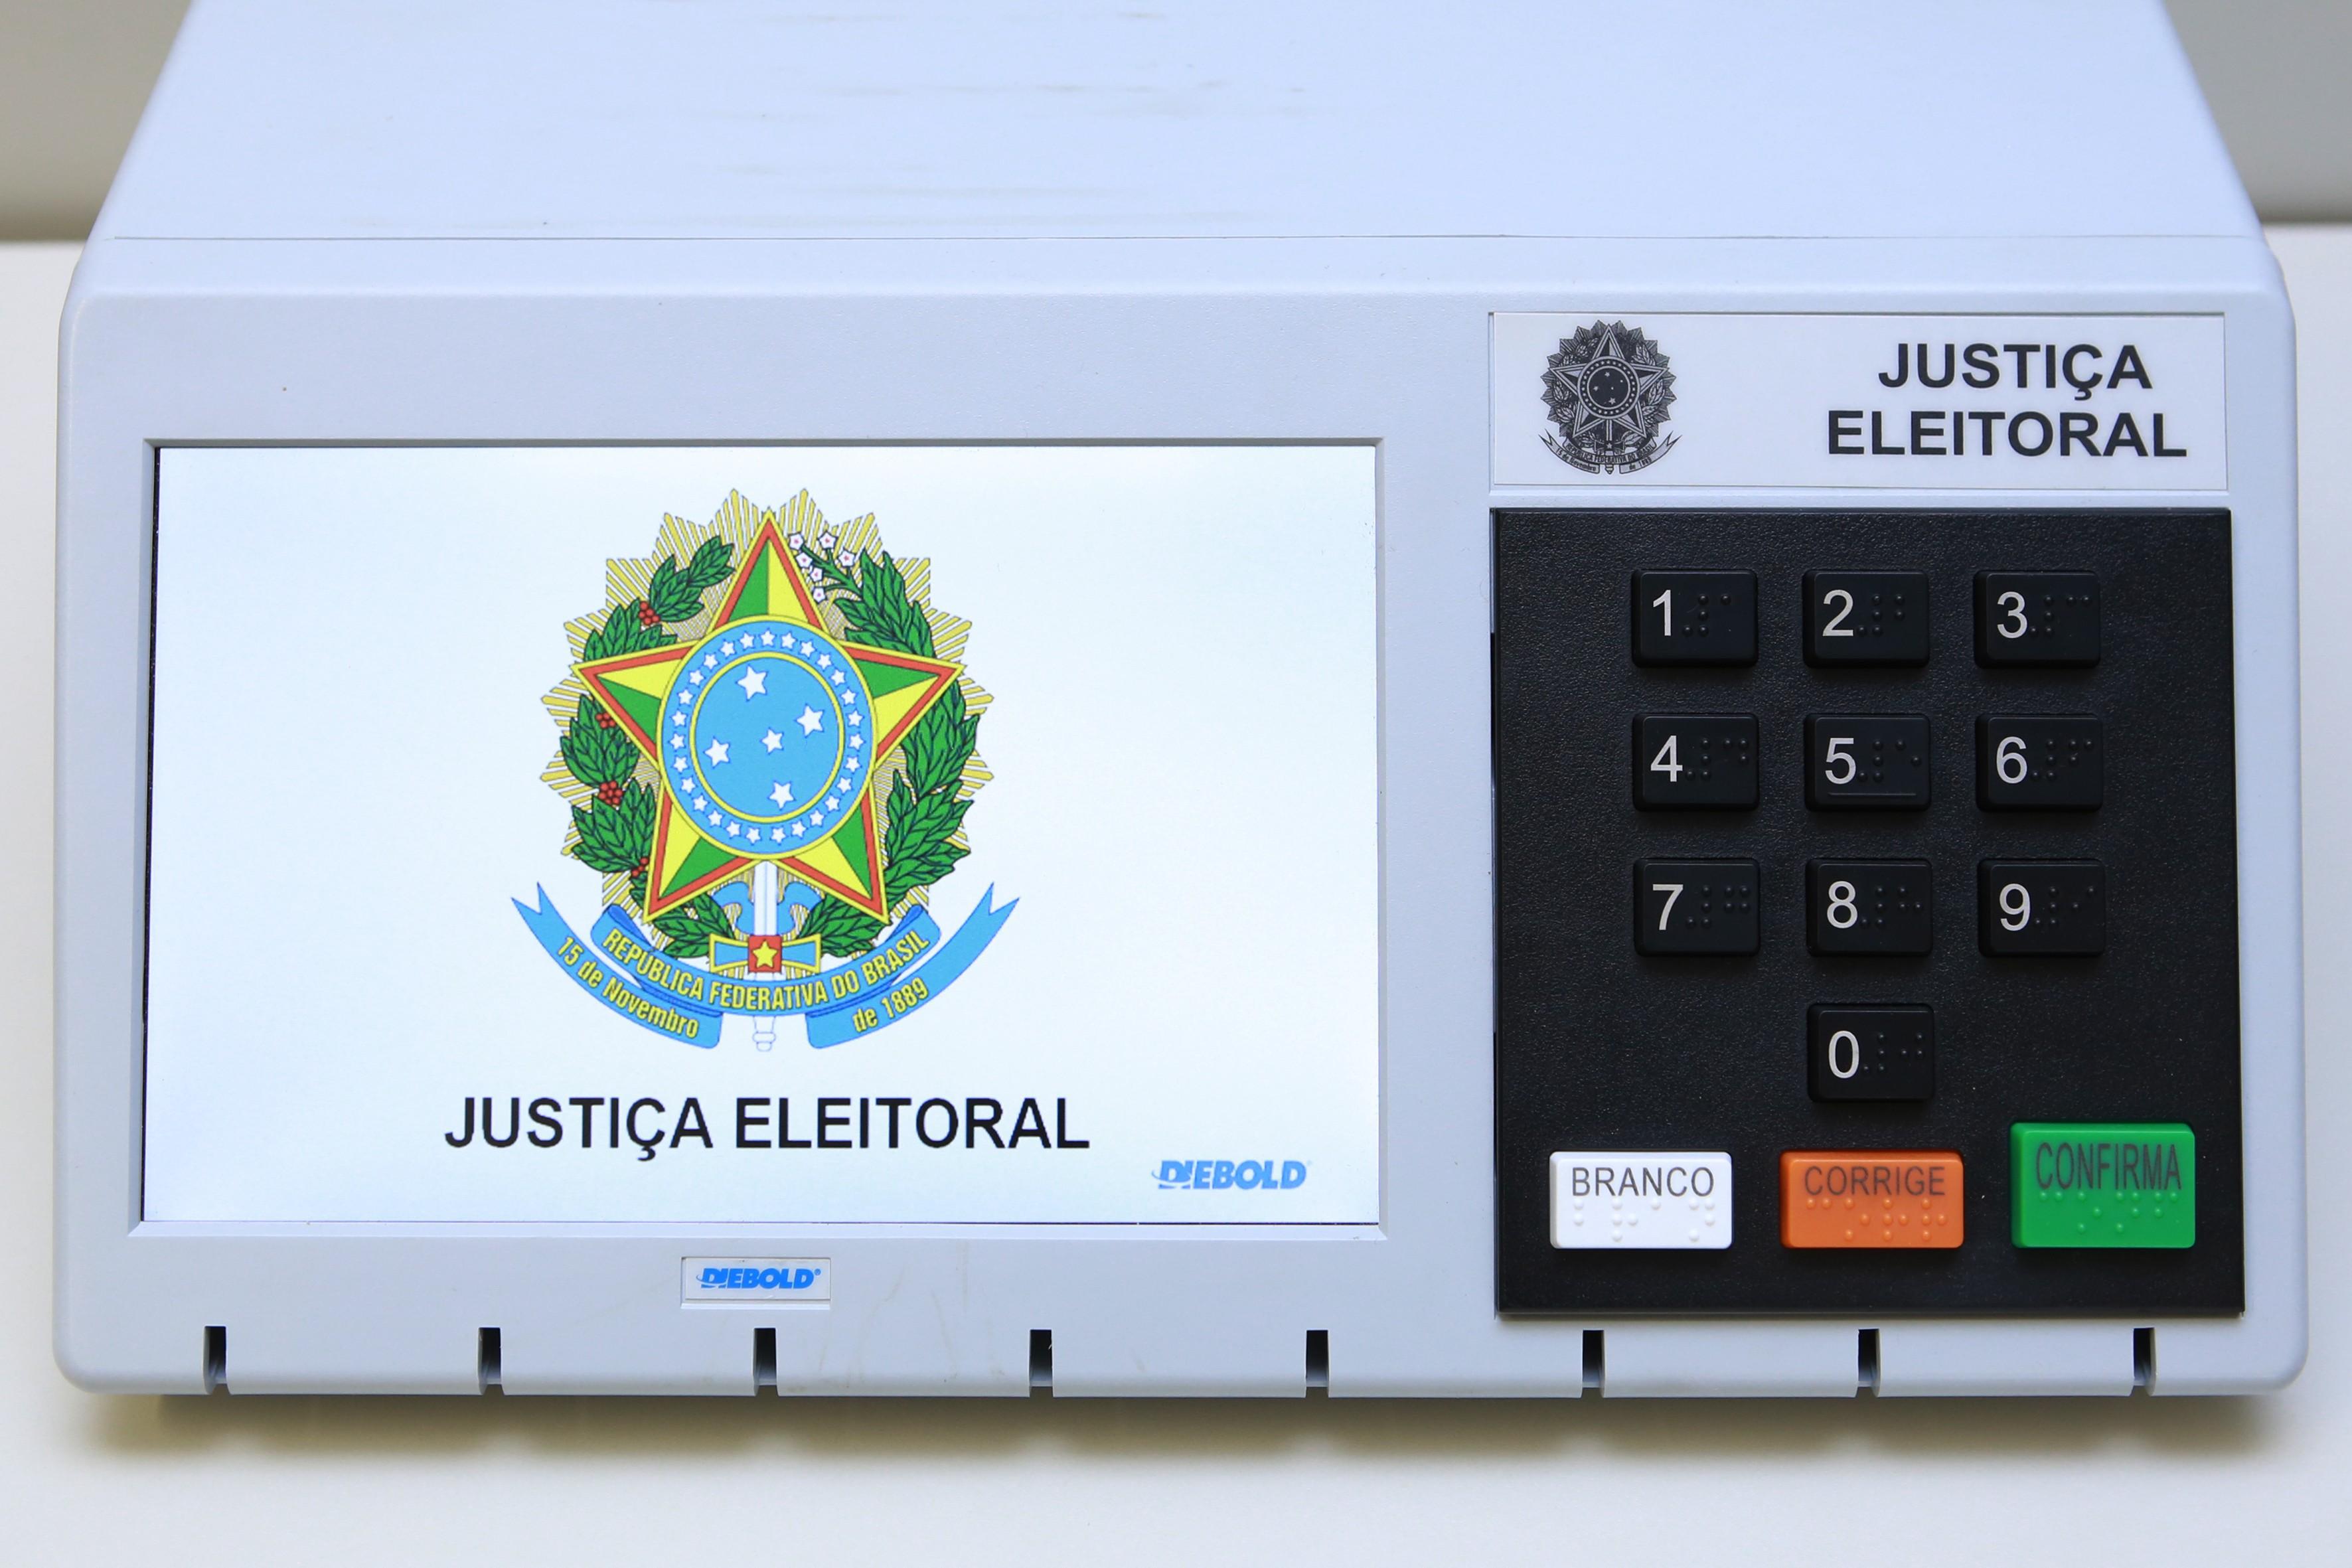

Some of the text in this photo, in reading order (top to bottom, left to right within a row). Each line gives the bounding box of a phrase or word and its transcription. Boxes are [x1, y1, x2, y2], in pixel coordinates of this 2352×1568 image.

[1878, 343, 2153, 402] JUSTIÇA
[1828, 410, 2188, 458] ELEITORAL
[1653, 589, 1672, 636] 1
[1822, 589, 1853, 637] 2
[1997, 591, 2027, 639] 3
[1650, 735, 1683, 782] 4
[1825, 738, 1856, 785] 5
[1996, 736, 2027, 784] 6
[1652, 884, 1684, 931] 7
[1827, 880, 1858, 929] 8
[1999, 883, 2031, 931] 9
[558, 936, 700, 1039] 15 de Novembro
[708, 980, 828, 1010] FEDERATIVA
[831, 970, 860, 999] DO
[861, 930, 930, 986] BRASIL
[852, 977, 929, 1033] de 1889
[1828, 1030, 1859, 1079] 0
[445, 1097, 1090, 1162] JUSTIÇA ELEITORAL
[1152, 1159, 1308, 1190] DIEBOLD
[1571, 1166, 1715, 1197] BRANCO
[1804, 1164, 1946, 1197] CORRIGE
[2036, 1142, 2182, 1191] CONFIRMA
